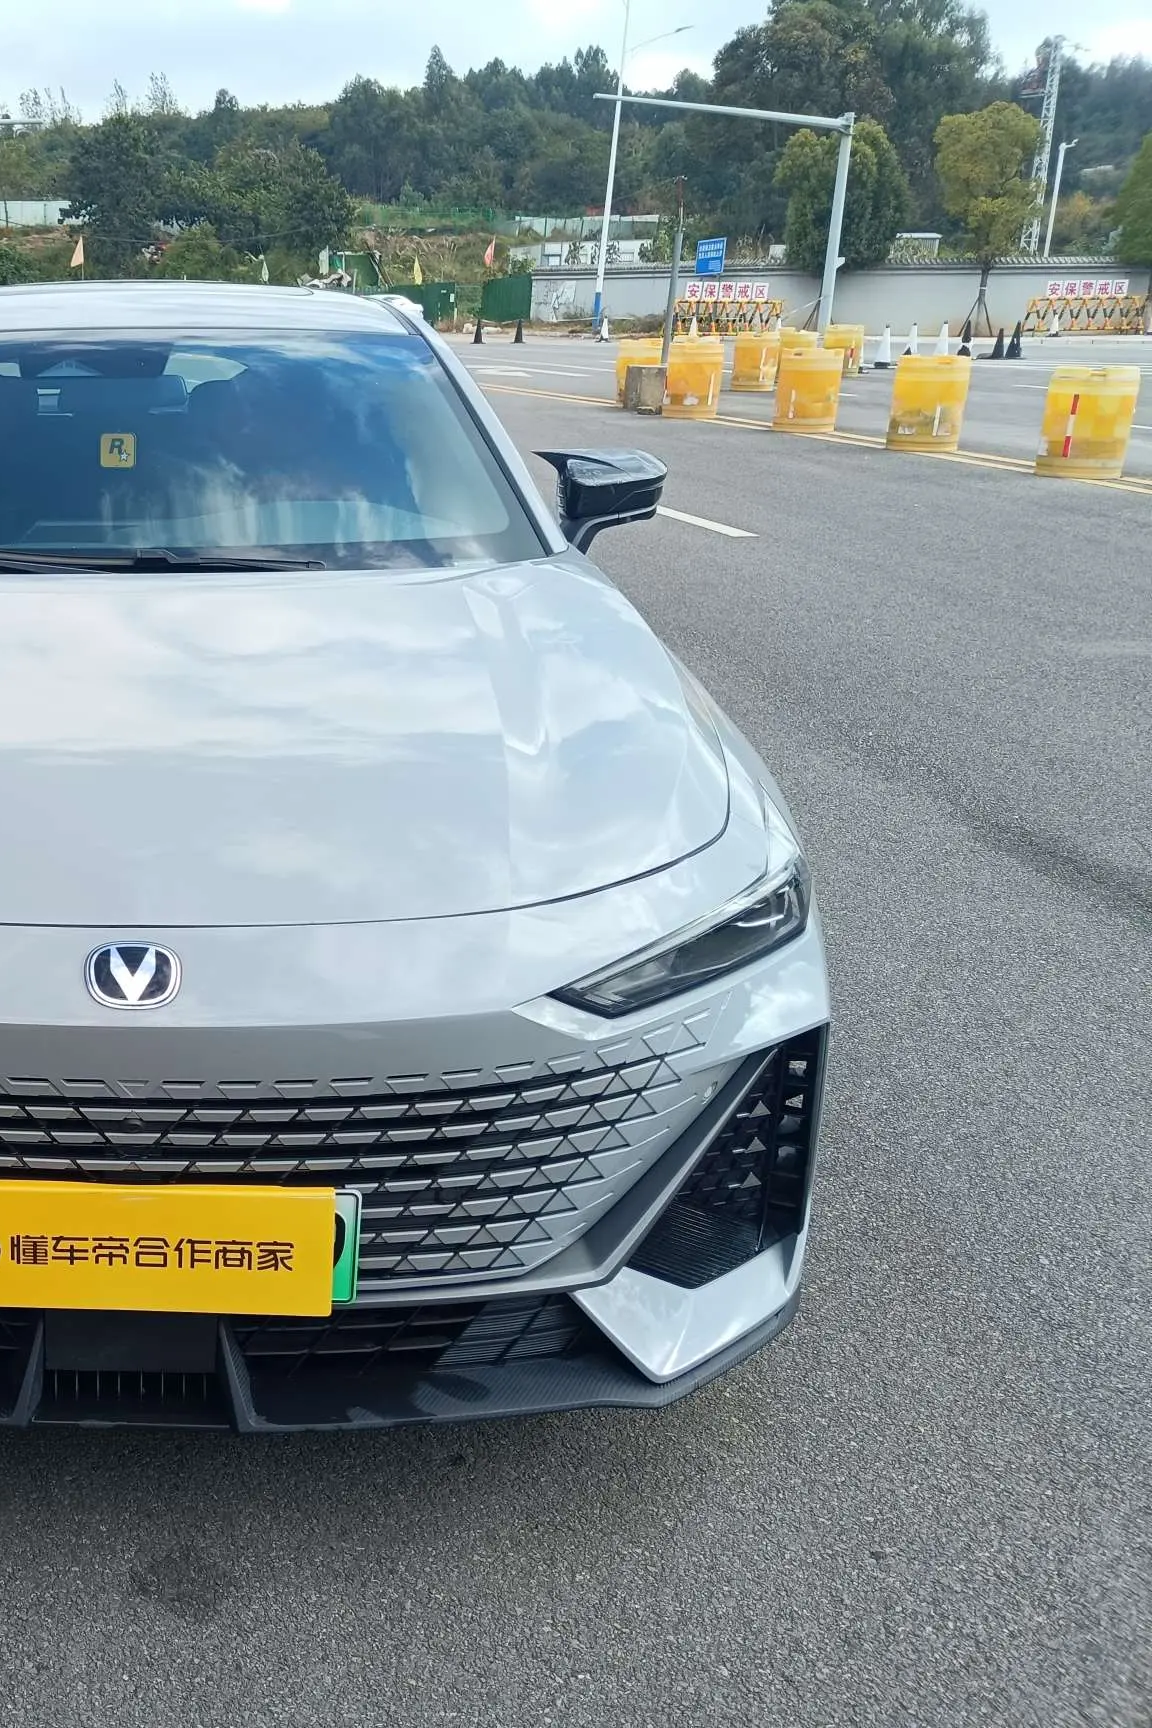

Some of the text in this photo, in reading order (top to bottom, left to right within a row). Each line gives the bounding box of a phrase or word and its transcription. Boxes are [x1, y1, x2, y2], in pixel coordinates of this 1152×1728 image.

[688, 283, 766, 298] 安保警戒区
[1048, 281, 1126, 296] 安保警戒区
[10, 1234, 295, 1272] 懂车帝合作商家
